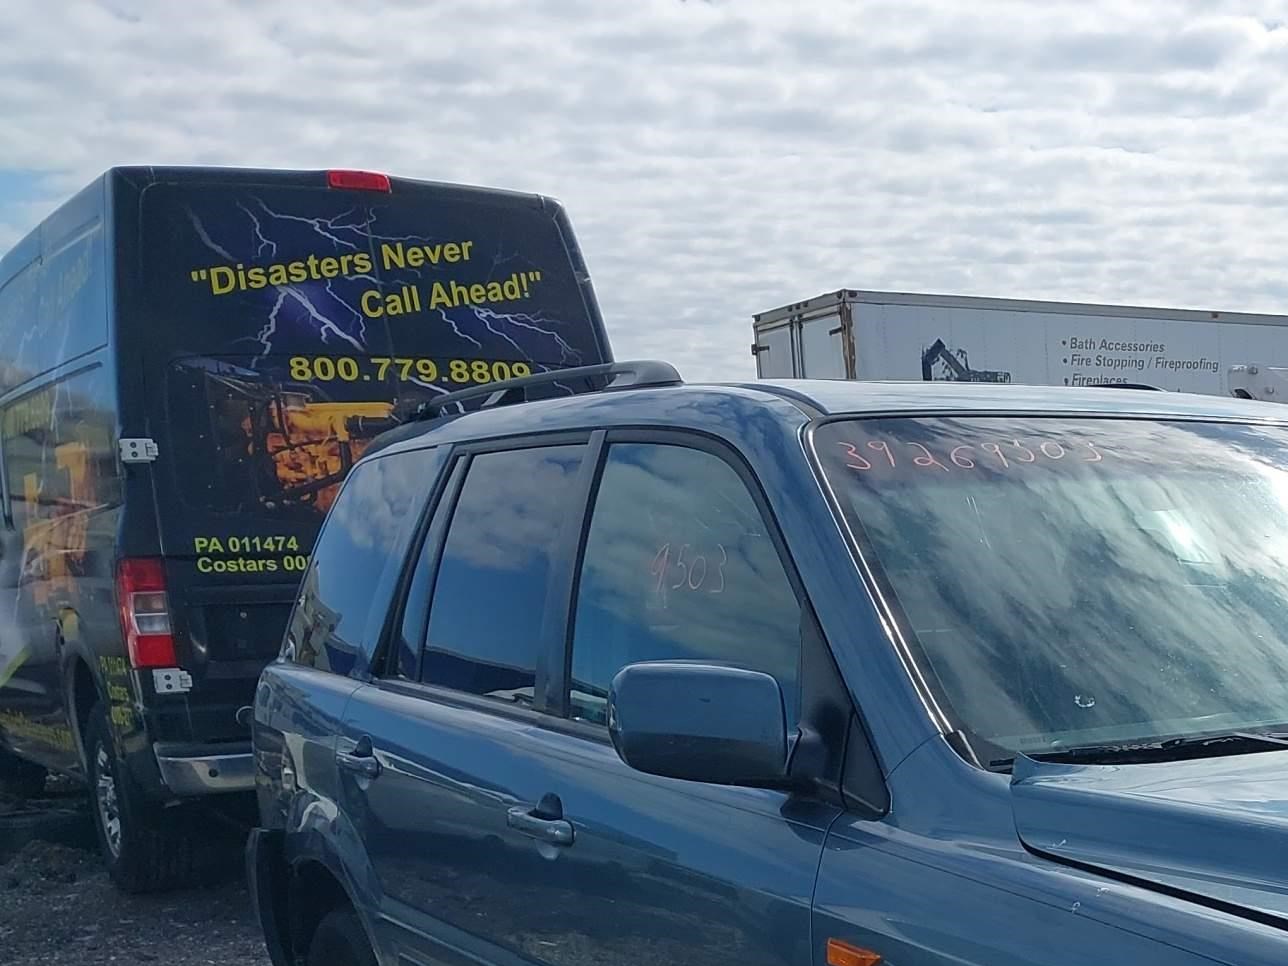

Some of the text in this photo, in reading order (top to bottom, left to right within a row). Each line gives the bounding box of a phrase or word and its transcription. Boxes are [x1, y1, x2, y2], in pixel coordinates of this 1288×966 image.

[191, 240, 473, 295] "Disasters Never
[361, 271, 542, 318] Call Ahead!"
[1070, 337, 1166, 353] Bath Accessories
[289, 356, 532, 383] 800.779.8809
[1070, 354, 1091, 367] Fire
[1095, 354, 1145, 370] Stopping
[1155, 356, 1219, 373] Fireproofing
[194, 536, 299, 553] PA 011474
[197, 556, 278, 573] Costars
